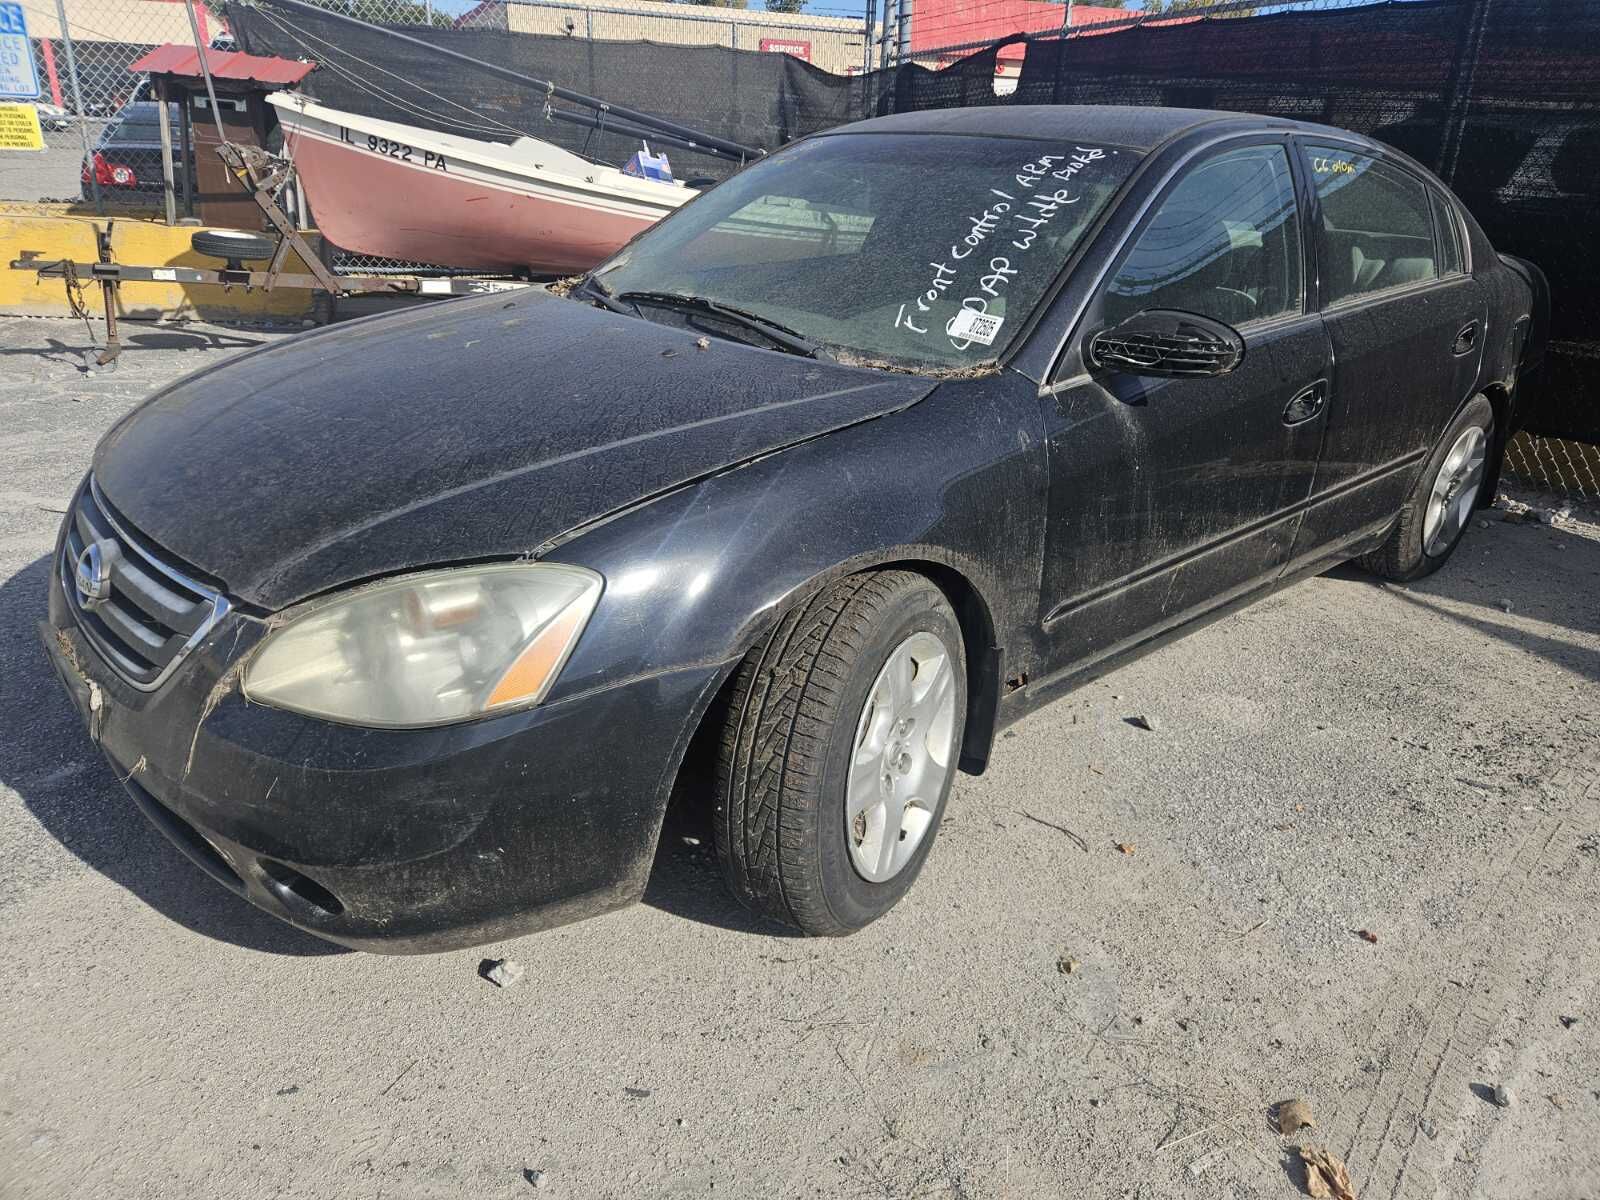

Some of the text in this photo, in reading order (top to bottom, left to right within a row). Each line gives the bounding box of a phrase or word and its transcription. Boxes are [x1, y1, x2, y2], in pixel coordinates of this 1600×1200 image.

[768, 43, 805, 54] SERVICE
[340, 126, 448, 172] IL 9322 PA
[895, 262, 957, 334] Front
